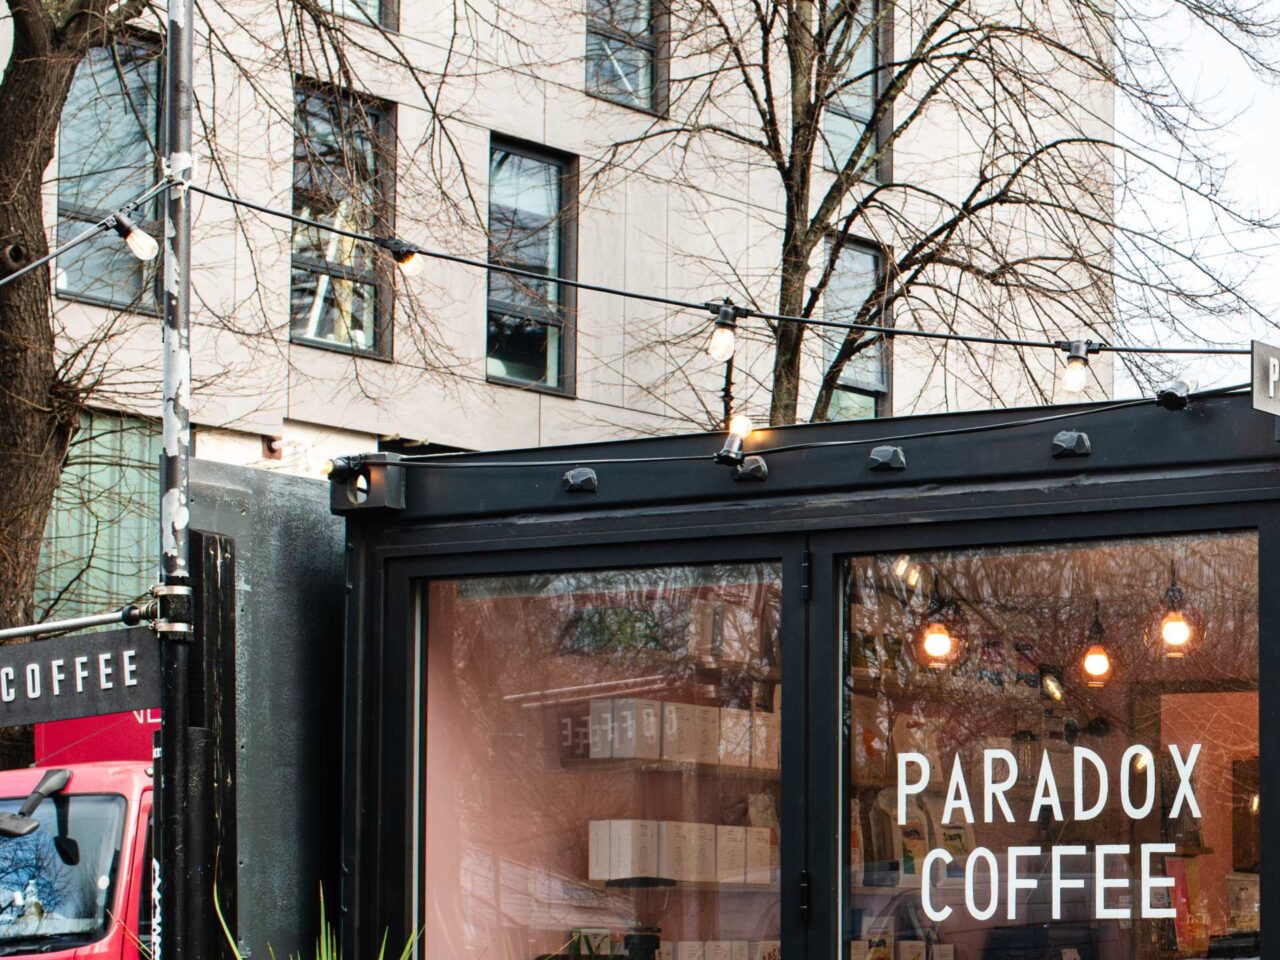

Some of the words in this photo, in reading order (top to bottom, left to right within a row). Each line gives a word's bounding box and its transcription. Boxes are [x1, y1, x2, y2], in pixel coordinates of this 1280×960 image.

[0, 649, 139, 703] COFFEE
[896, 743, 1203, 825] PARADOX
[920, 842, 1178, 922] COFFEE
